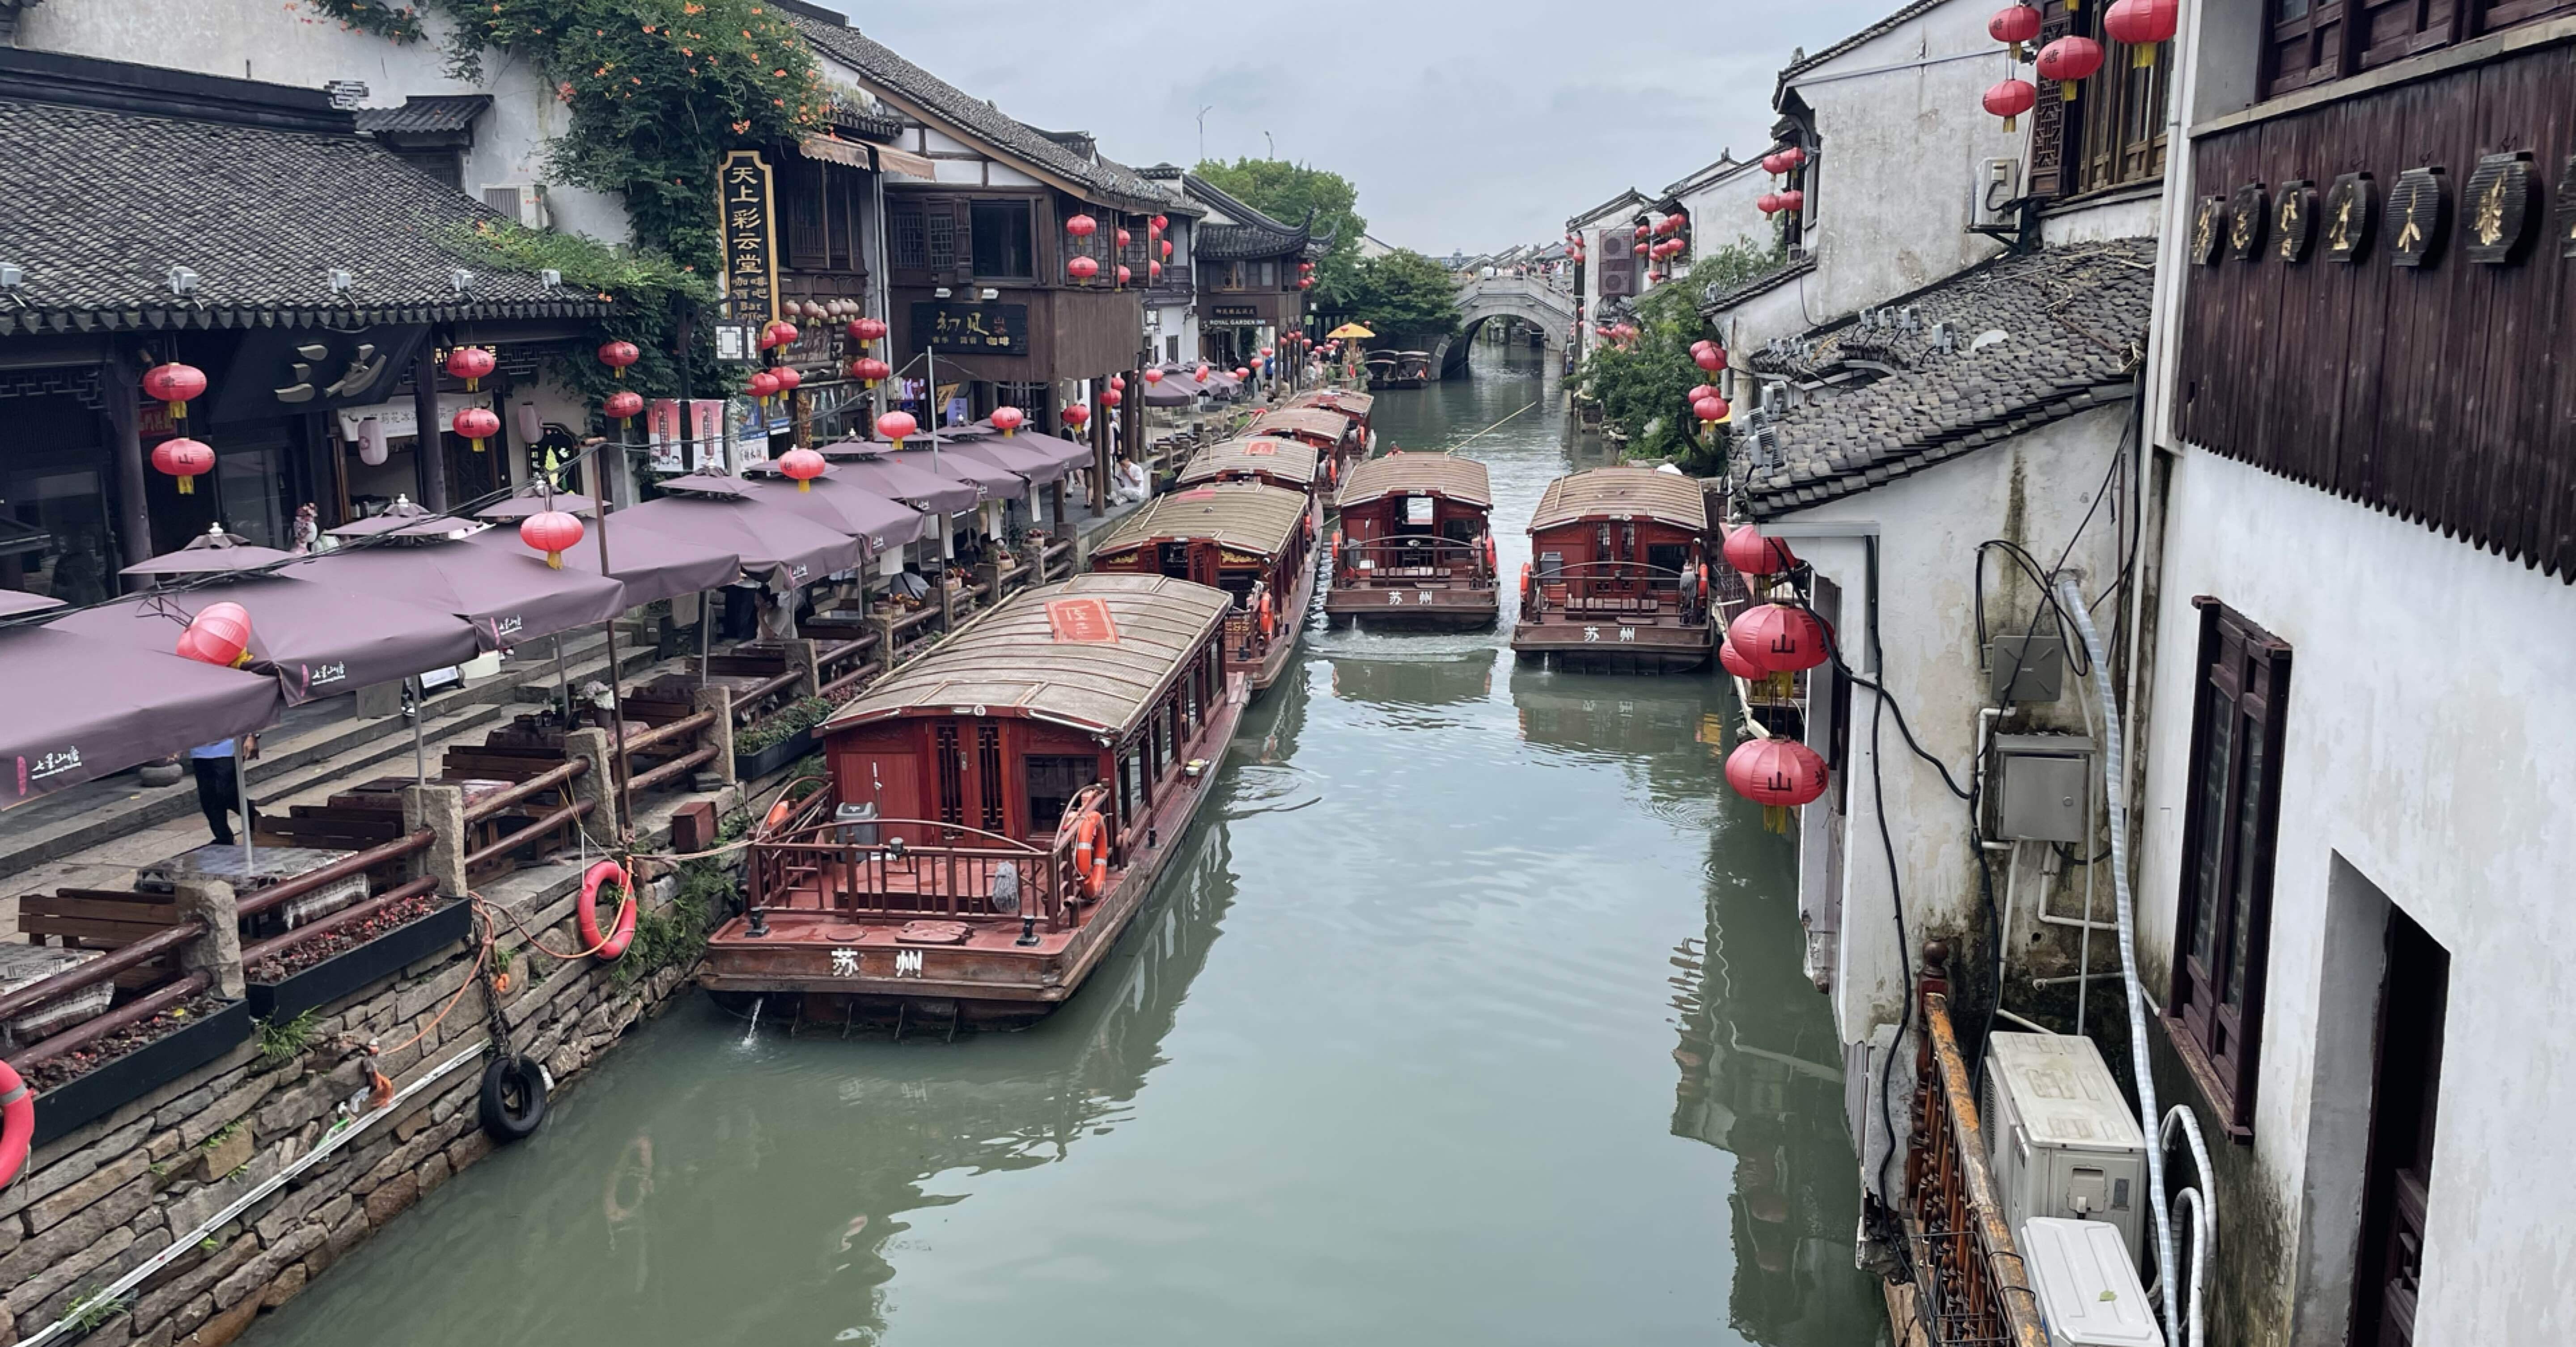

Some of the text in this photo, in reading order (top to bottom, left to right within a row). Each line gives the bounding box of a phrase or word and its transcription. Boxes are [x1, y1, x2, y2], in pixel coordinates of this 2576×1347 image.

[729, 167, 763, 274] 天上彩云堂
[937, 311, 989, 336] 初见
[1388, 591, 1432, 605] 苏州
[1584, 626, 1635, 642] 苏州
[831, 948, 922, 978] 苏州
